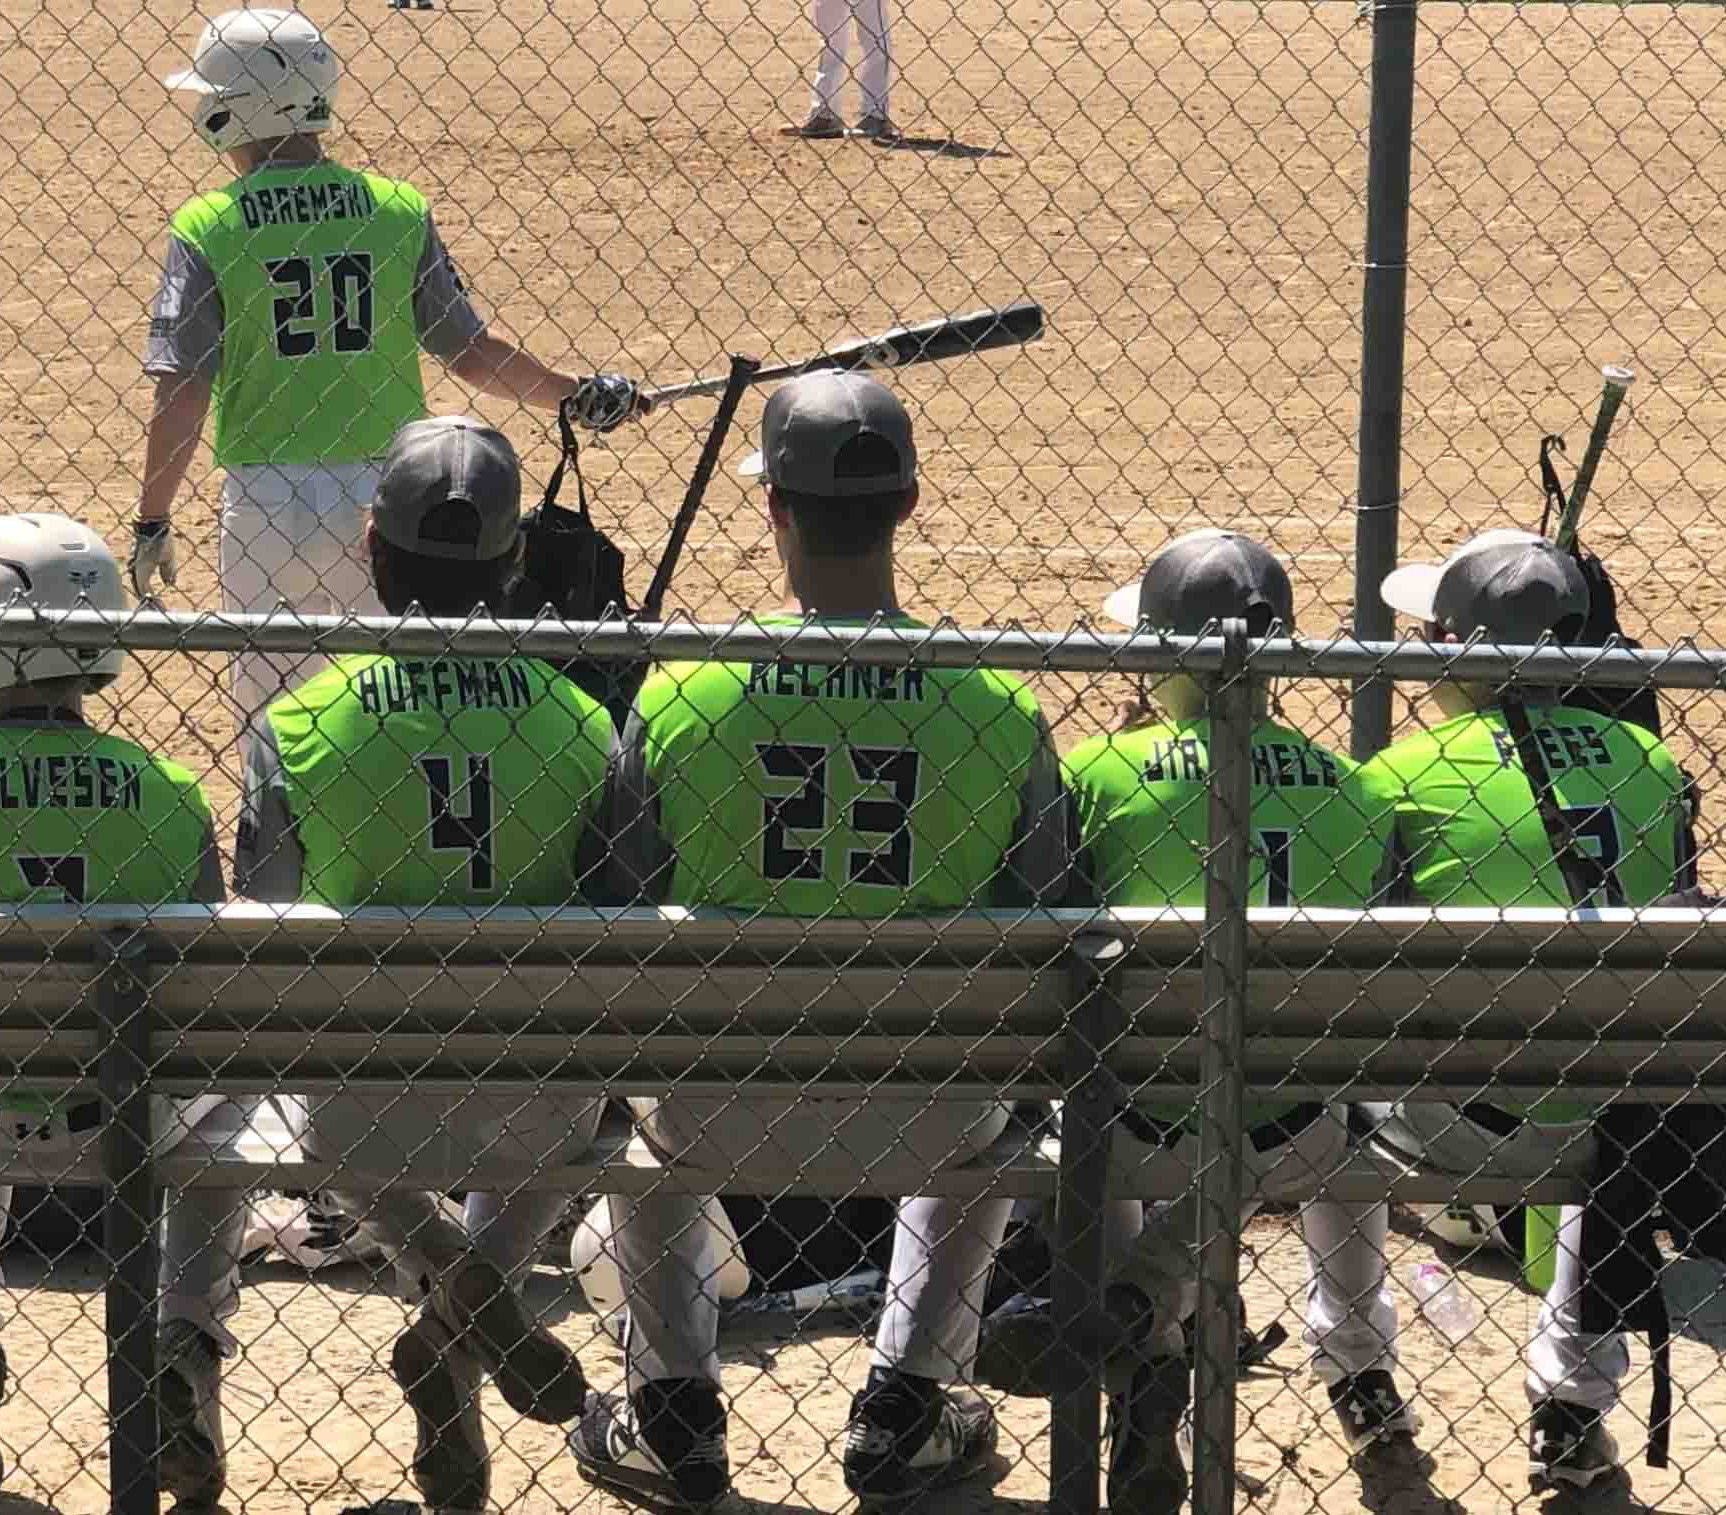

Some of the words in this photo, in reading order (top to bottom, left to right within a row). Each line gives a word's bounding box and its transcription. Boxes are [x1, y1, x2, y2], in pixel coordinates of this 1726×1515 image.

[265, 251, 374, 359] 20
[357, 658, 532, 714] HUFFMAN
[416, 752, 495, 893] 4
[753, 740, 921, 887] 23
